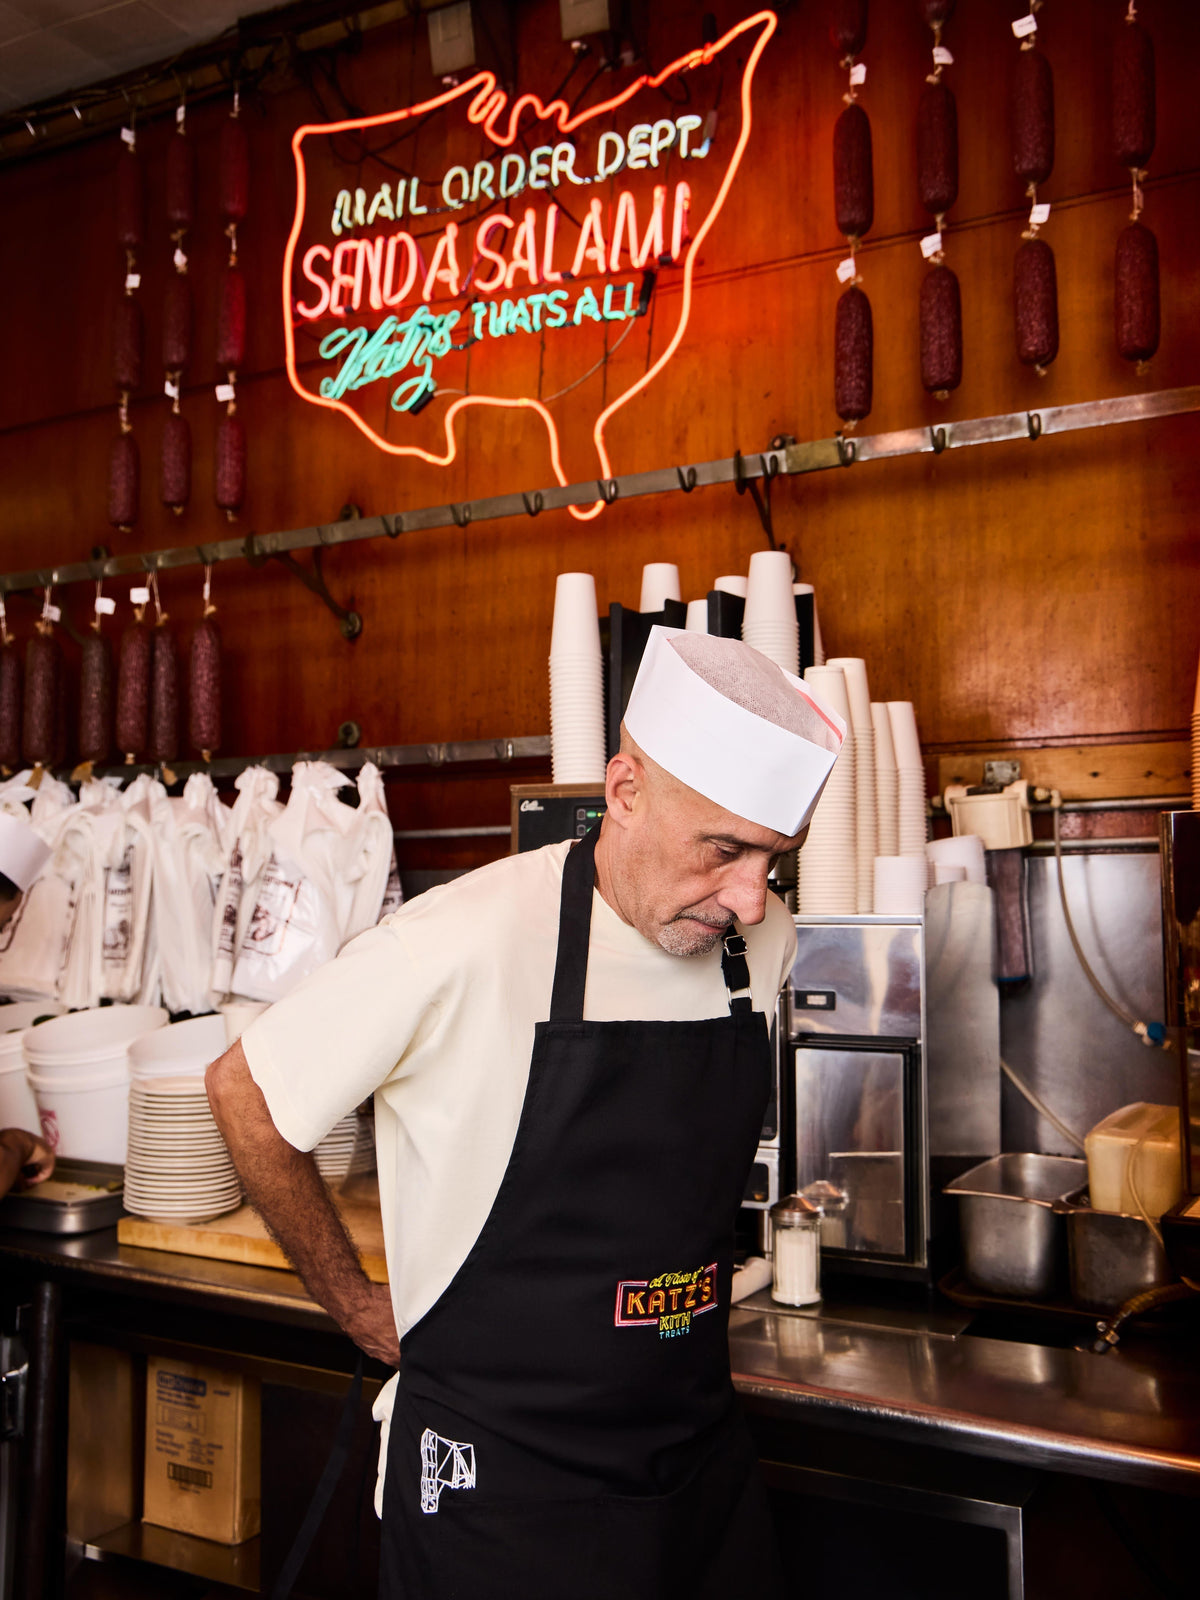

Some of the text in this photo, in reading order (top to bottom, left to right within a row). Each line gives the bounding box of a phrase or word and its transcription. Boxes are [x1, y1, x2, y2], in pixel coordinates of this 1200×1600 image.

[331, 176, 428, 236] MAIL
[442, 142, 593, 211] ORDER
[297, 182, 691, 319] SEND A SALAMI
[573, 282, 637, 326] ALL
[626, 1276, 712, 1315] KATZ'S
[665, 1270, 692, 1287] Taste
[691, 1266, 704, 1284] of
[659, 1311, 692, 1331] KITH
[659, 1325, 691, 1340] TREATS
